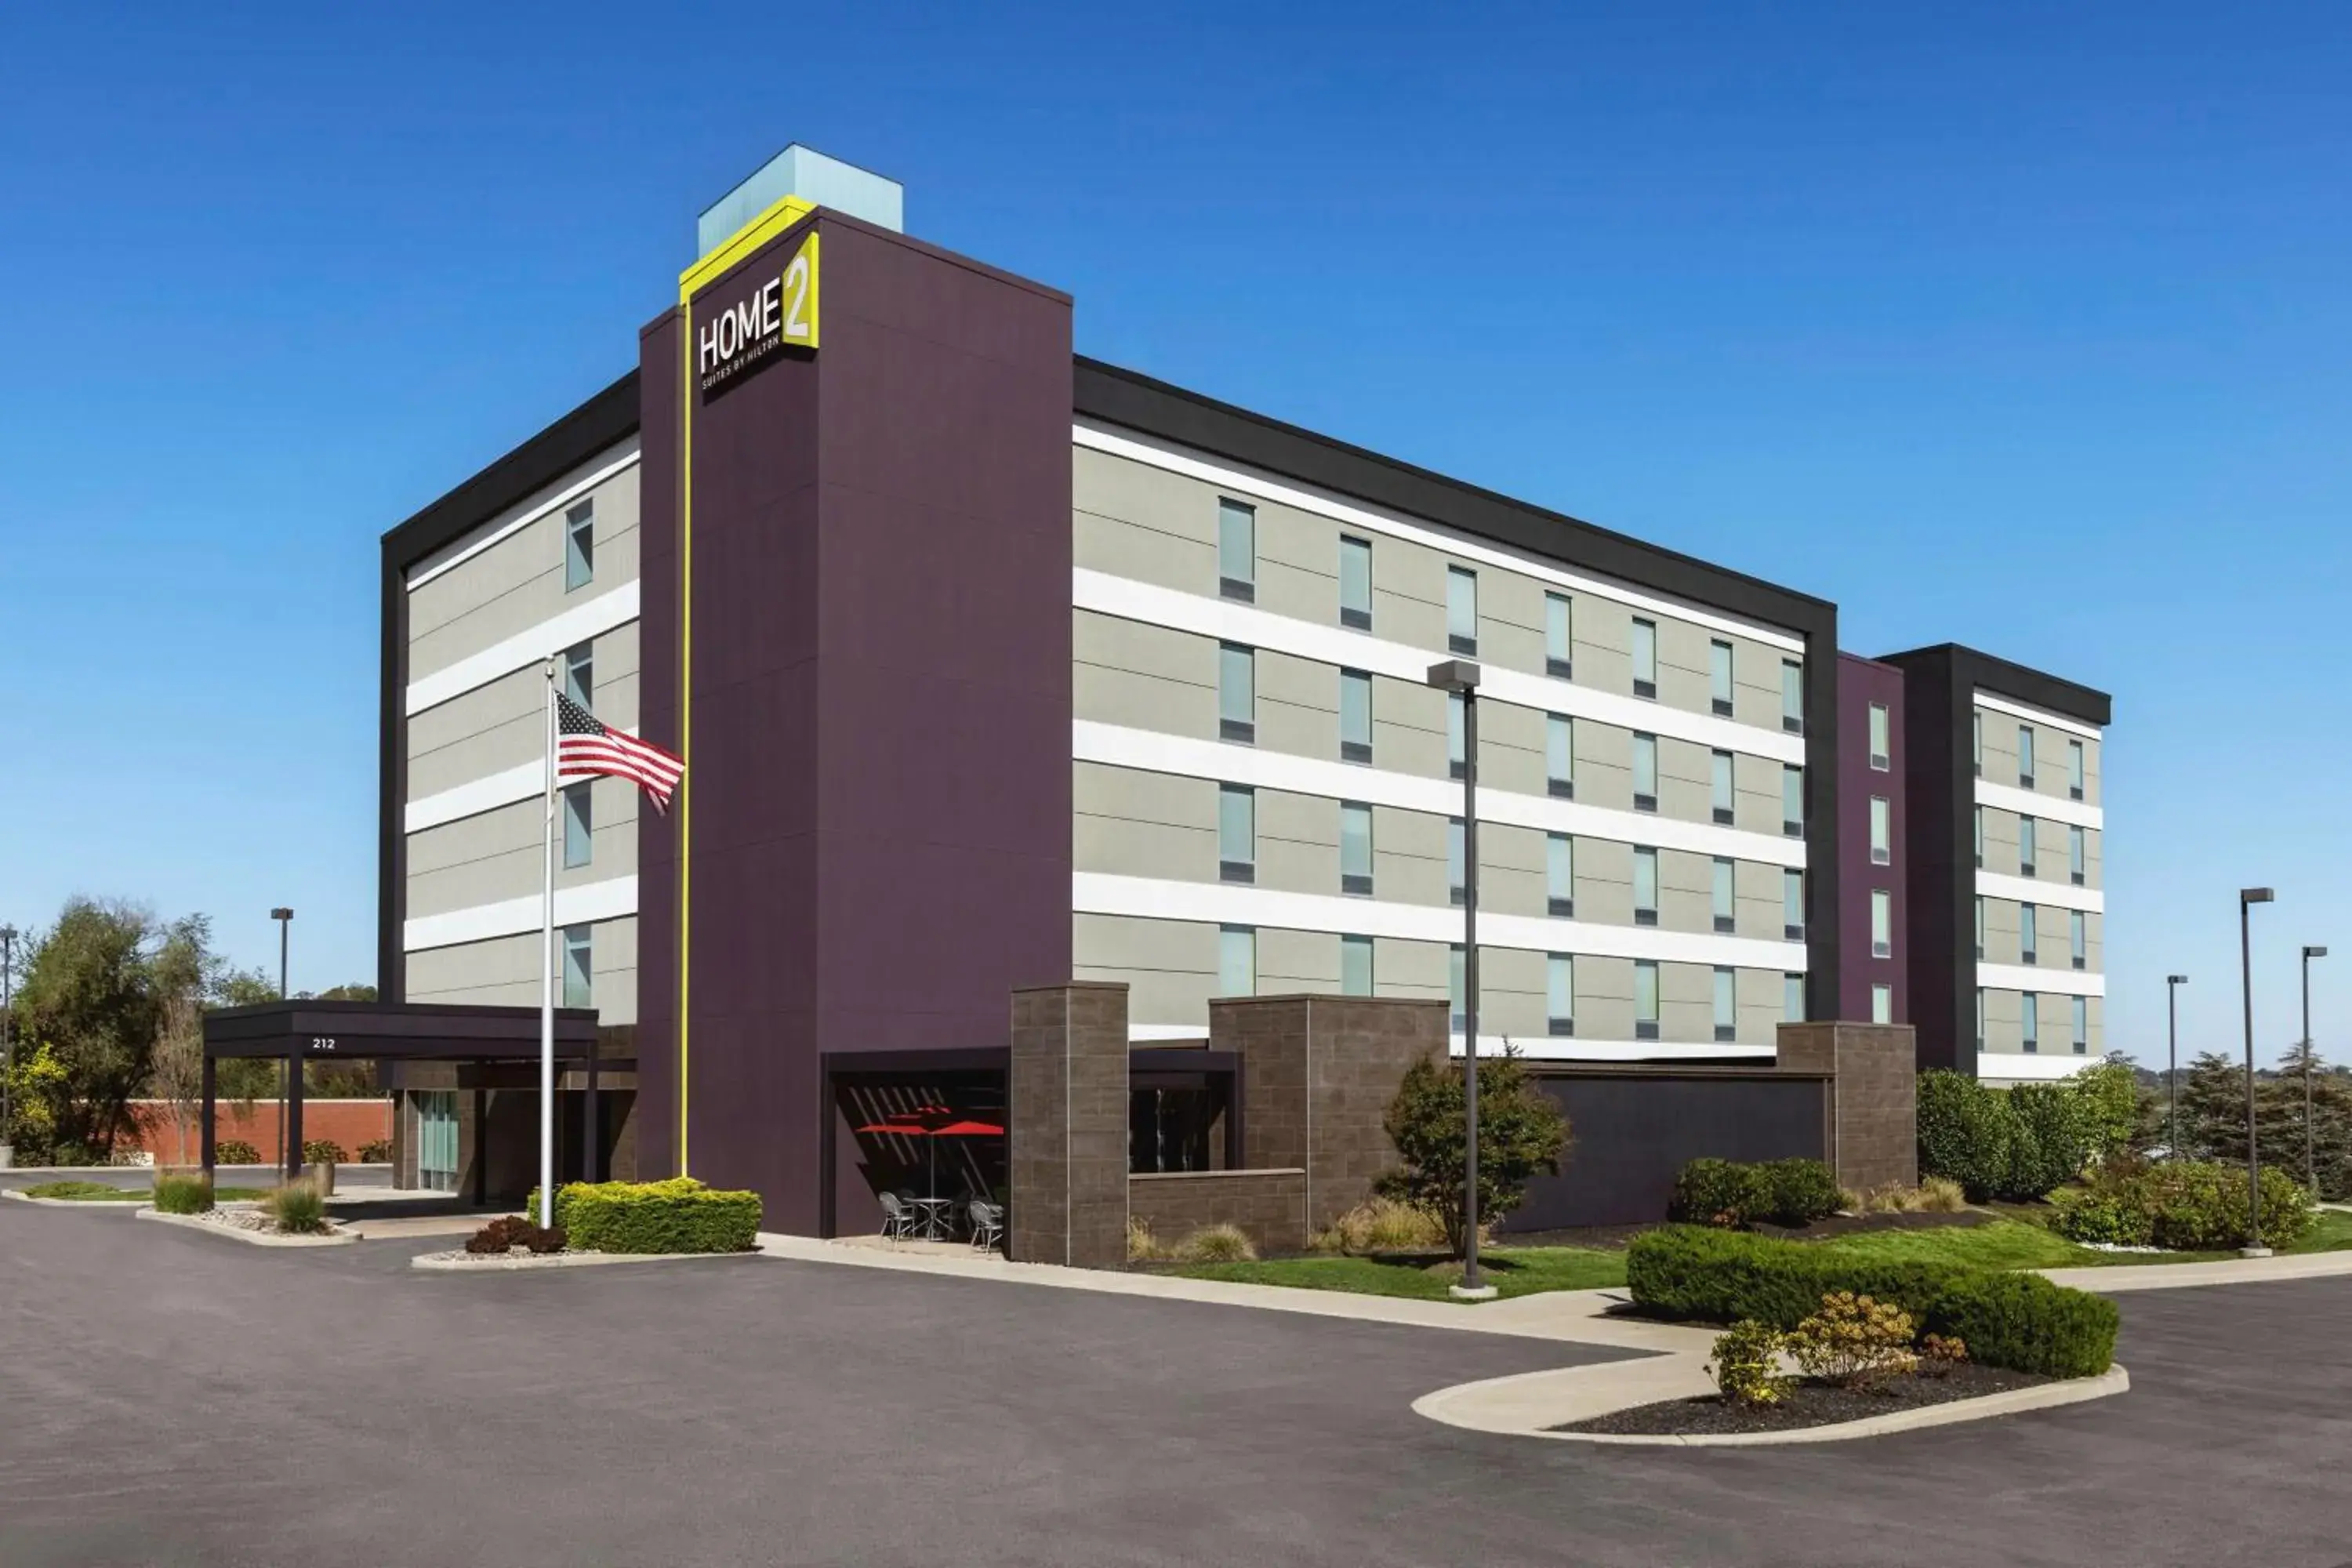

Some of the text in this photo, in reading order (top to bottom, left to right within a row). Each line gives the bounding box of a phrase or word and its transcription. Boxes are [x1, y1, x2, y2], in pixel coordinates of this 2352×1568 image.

[700, 255, 809, 374] HOME 2
[702, 336, 779, 390] SUITES BY HILTON
[313, 1038, 336, 1050] 212
